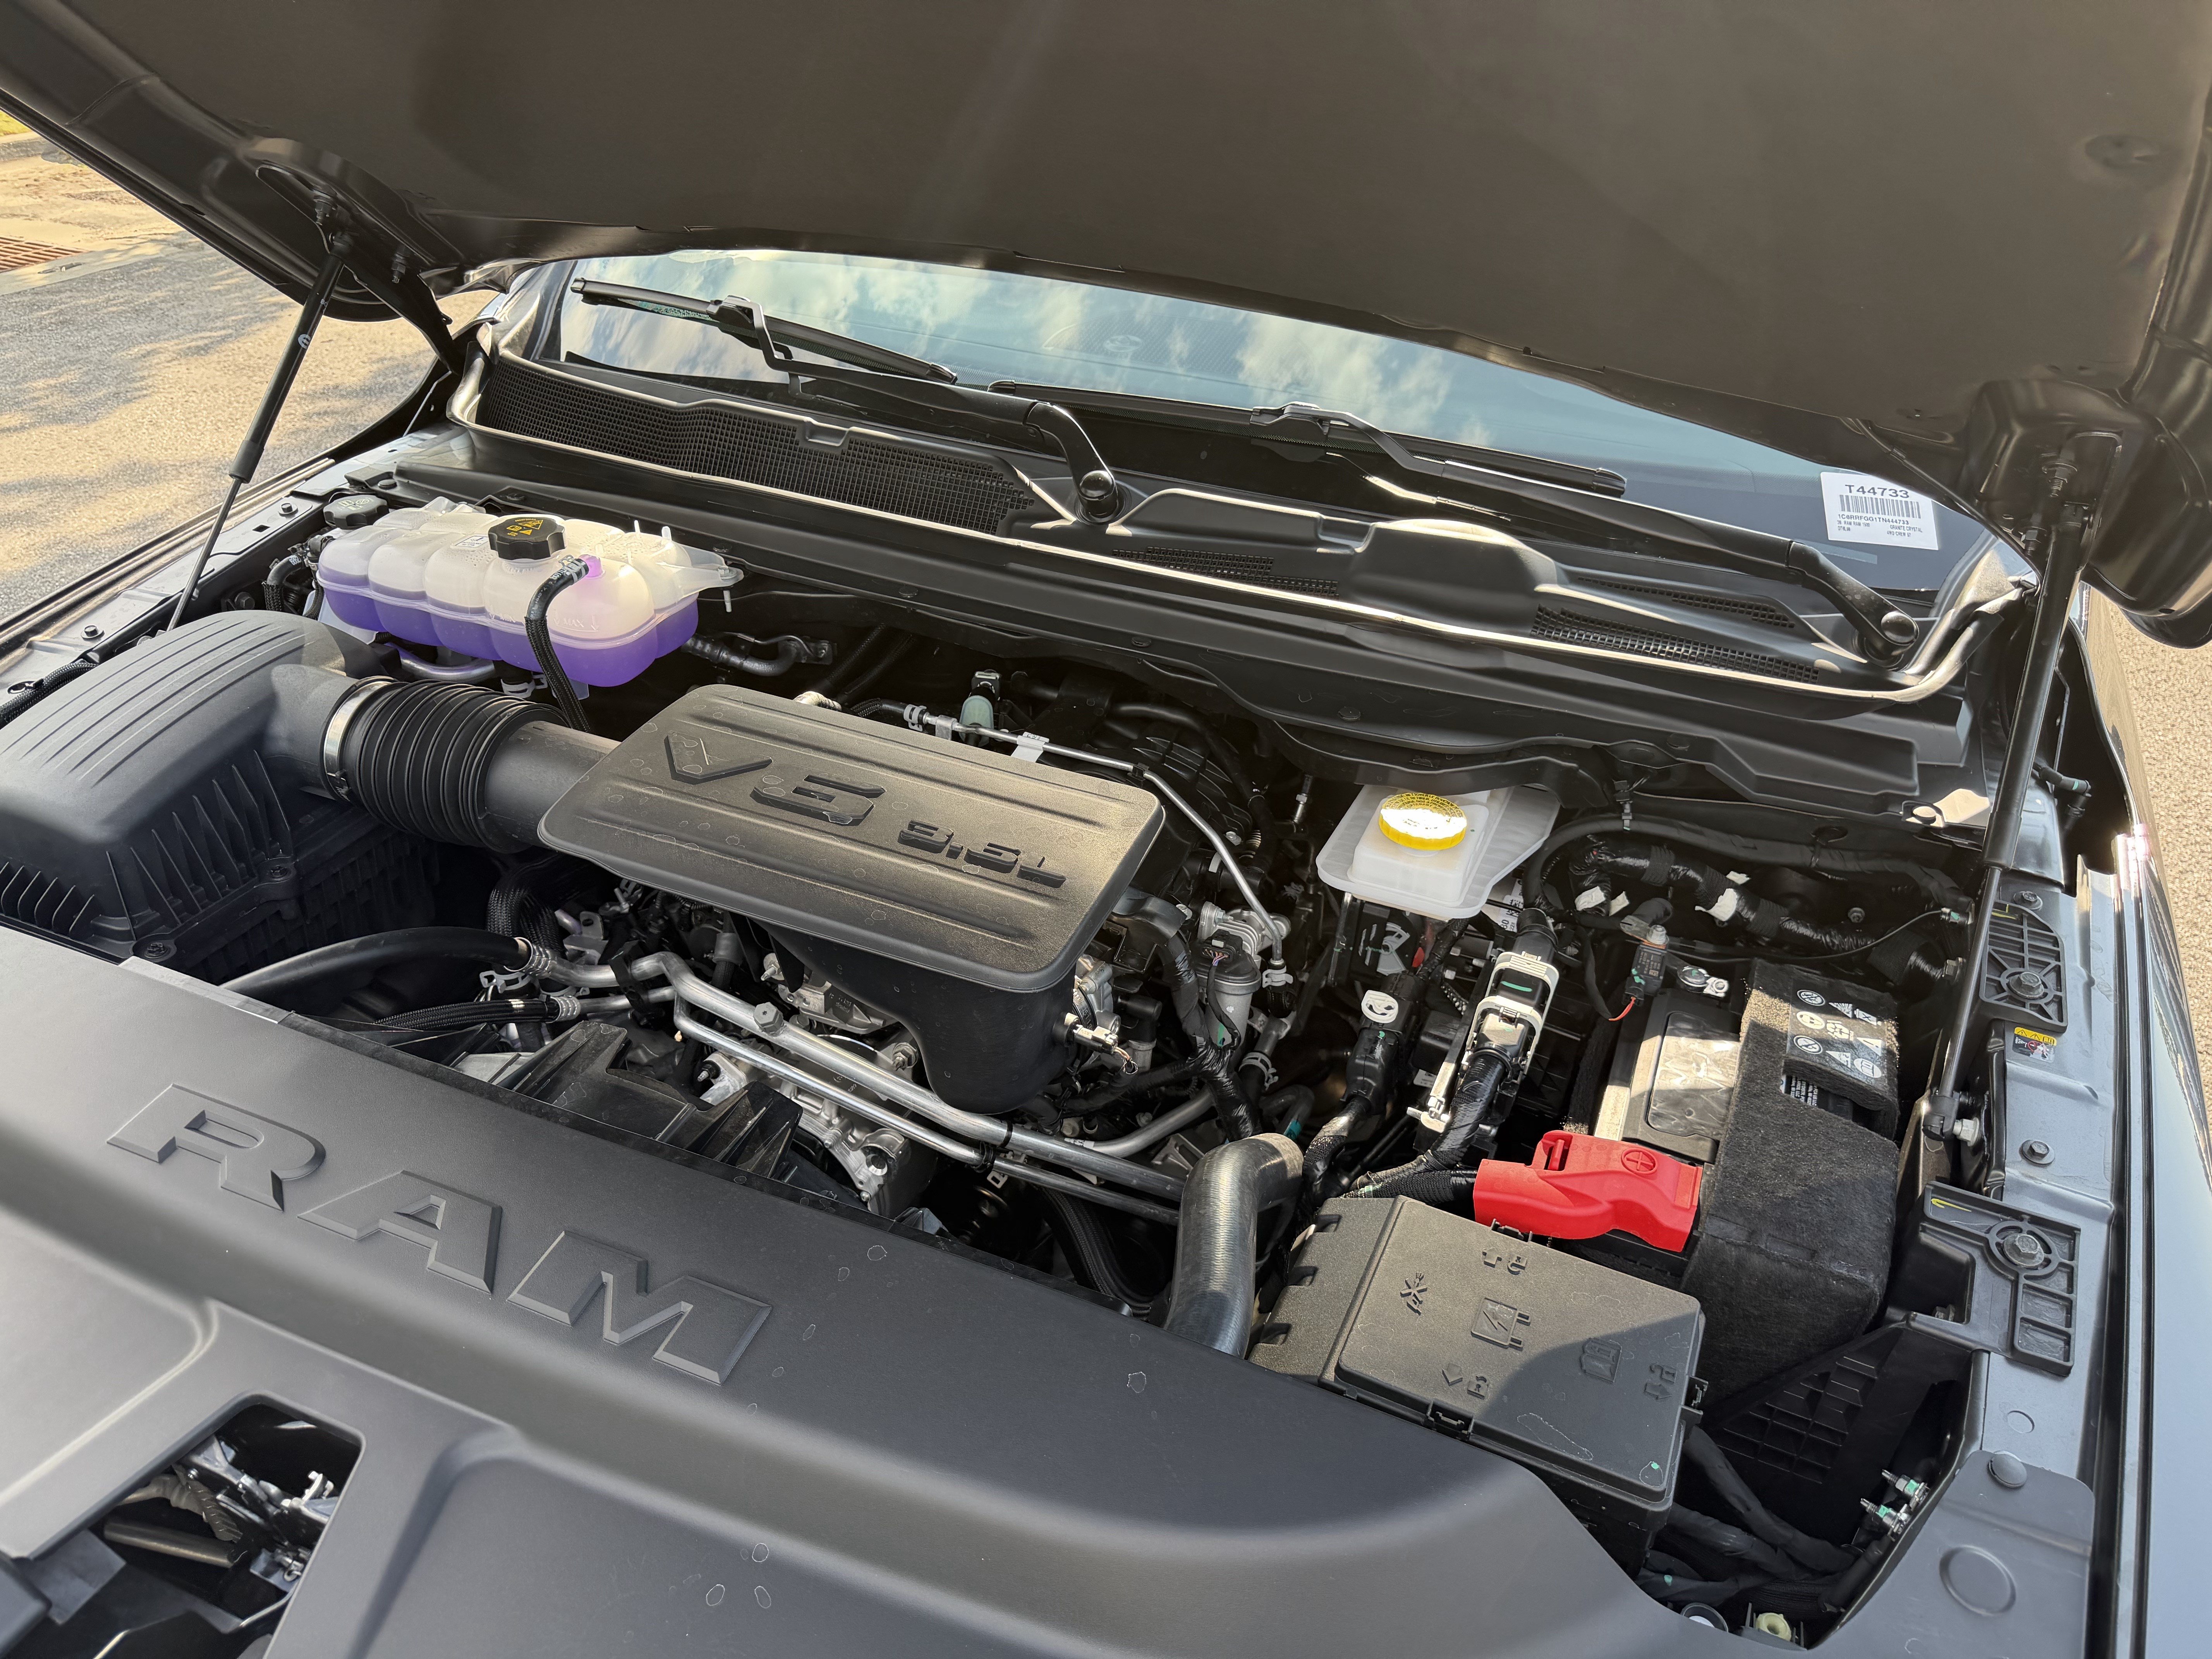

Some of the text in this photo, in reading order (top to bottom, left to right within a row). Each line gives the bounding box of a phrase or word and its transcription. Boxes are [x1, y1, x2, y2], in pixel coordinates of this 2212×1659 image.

[1845, 484, 1909, 498] T44733
[563, 617, 584, 628] MAX
[897, 819, 1066, 888] 3.6L
[107, 1084, 771, 1385] RAM
